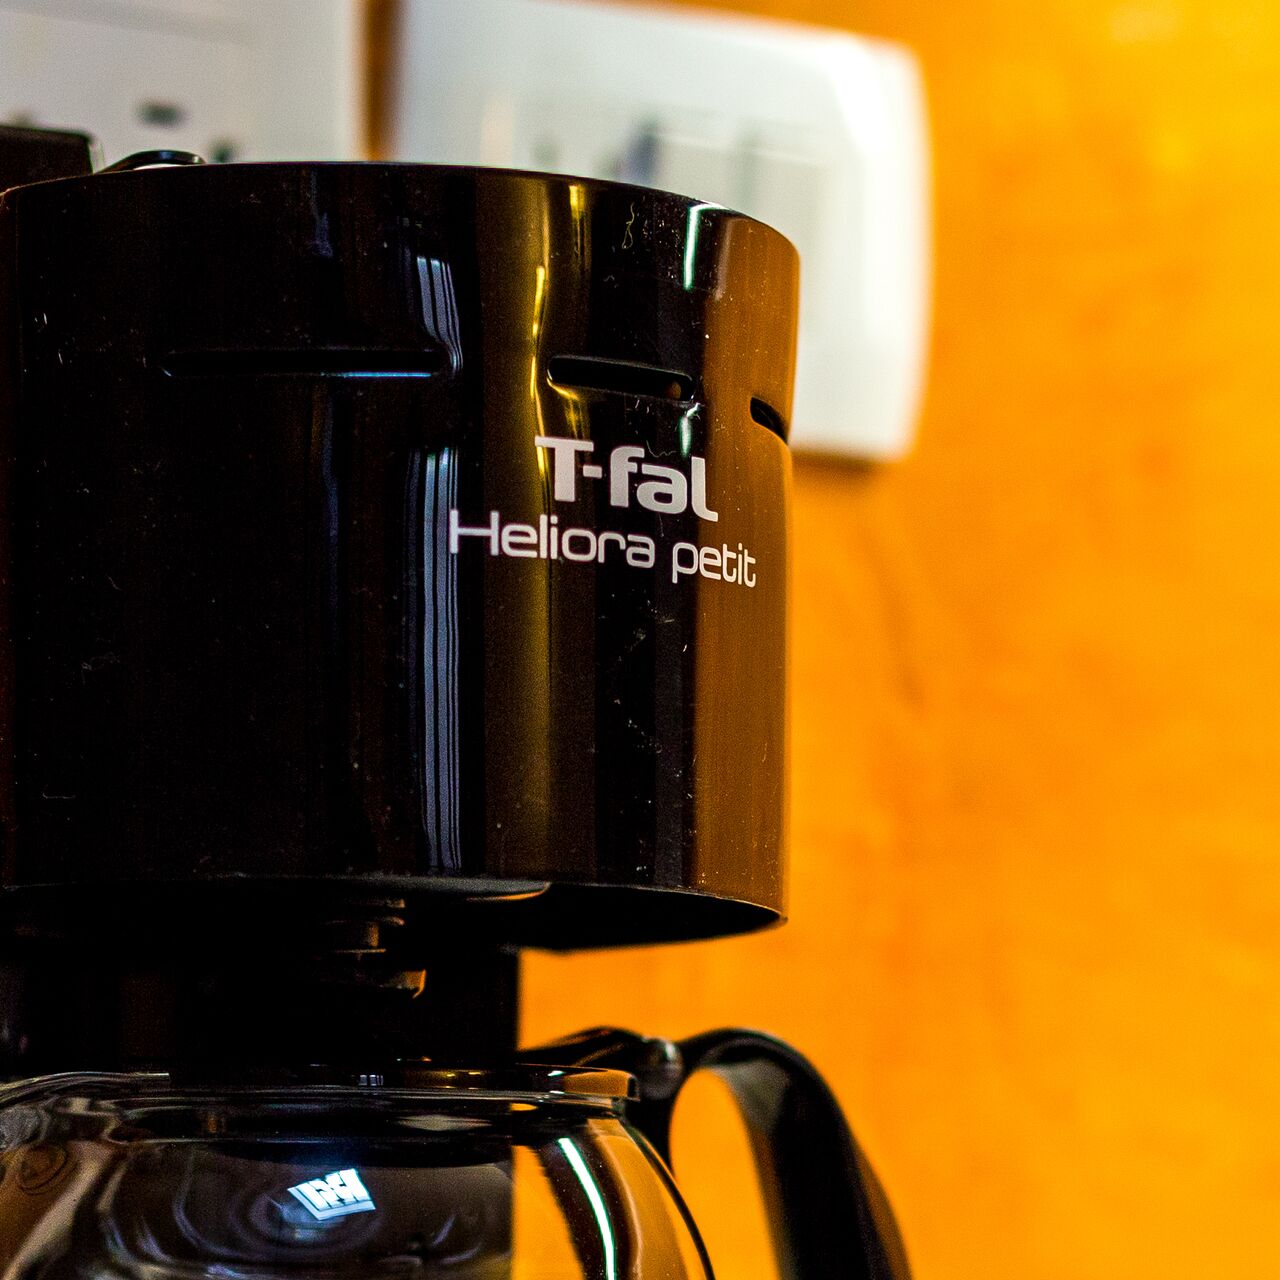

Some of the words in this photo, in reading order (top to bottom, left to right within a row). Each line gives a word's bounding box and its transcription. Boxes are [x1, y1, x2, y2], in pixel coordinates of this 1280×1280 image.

[534, 434, 719, 523] T-fal
[448, 508, 656, 569] Heliora
[671, 541, 757, 588] petit
